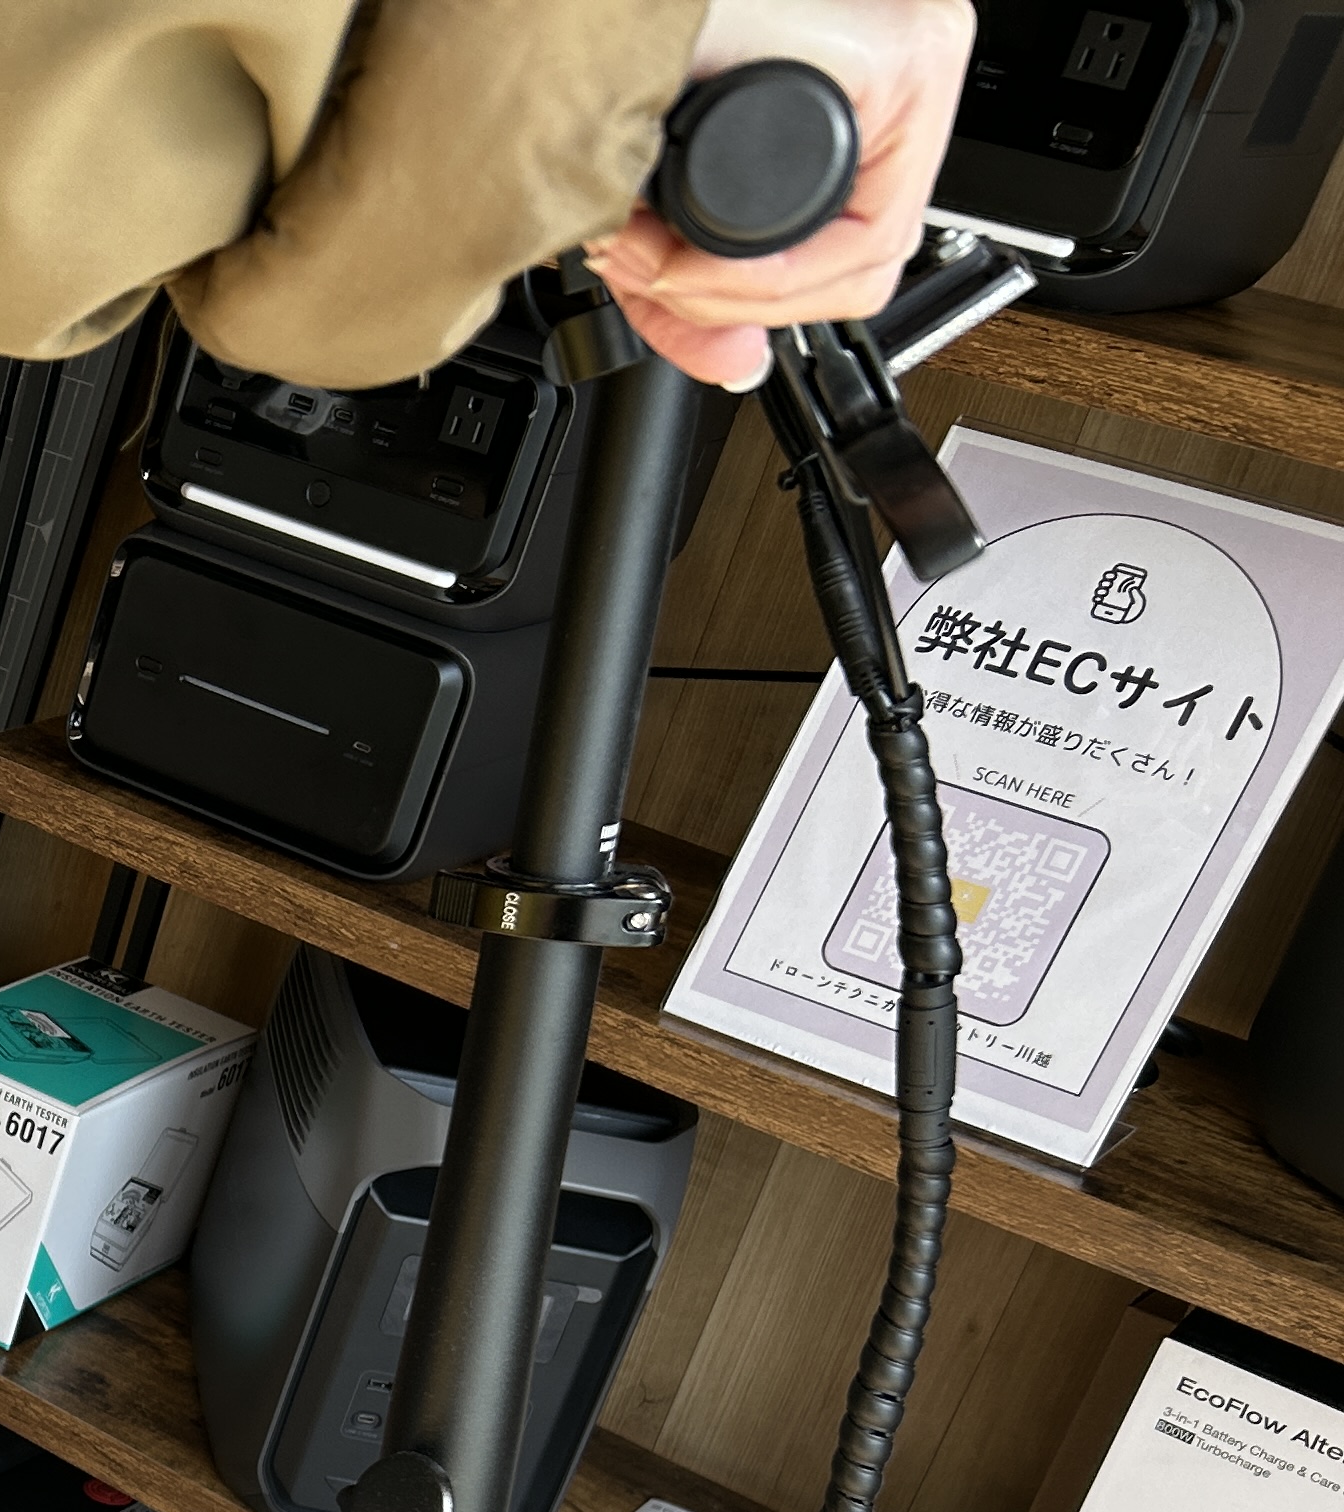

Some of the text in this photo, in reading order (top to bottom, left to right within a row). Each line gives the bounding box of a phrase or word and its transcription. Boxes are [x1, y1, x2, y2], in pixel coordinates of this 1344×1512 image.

[914, 604, 1264, 741] 弊社ECサイト
[923, 689, 1196, 786] 得な情報が盛りだくさん！
[972, 766, 1076, 809] SCAN HERE
[500, 892, 520, 930] CLOSE
[124, 1000, 167, 1023] EARTH
[169, 1018, 217, 1044] TESTER
[3, 1090, 34, 1113] EARTH
[35, 1104, 68, 1128] TESTER
[5, 1110, 65, 1156] 6017
[1176, 1376, 1344, 1464] EcoFlow Alte
[1155, 1419, 1272, 1479] 800W Turbocharge
[1163, 1406, 1341, 1492] 3-in-1 Battery Charge & Care
